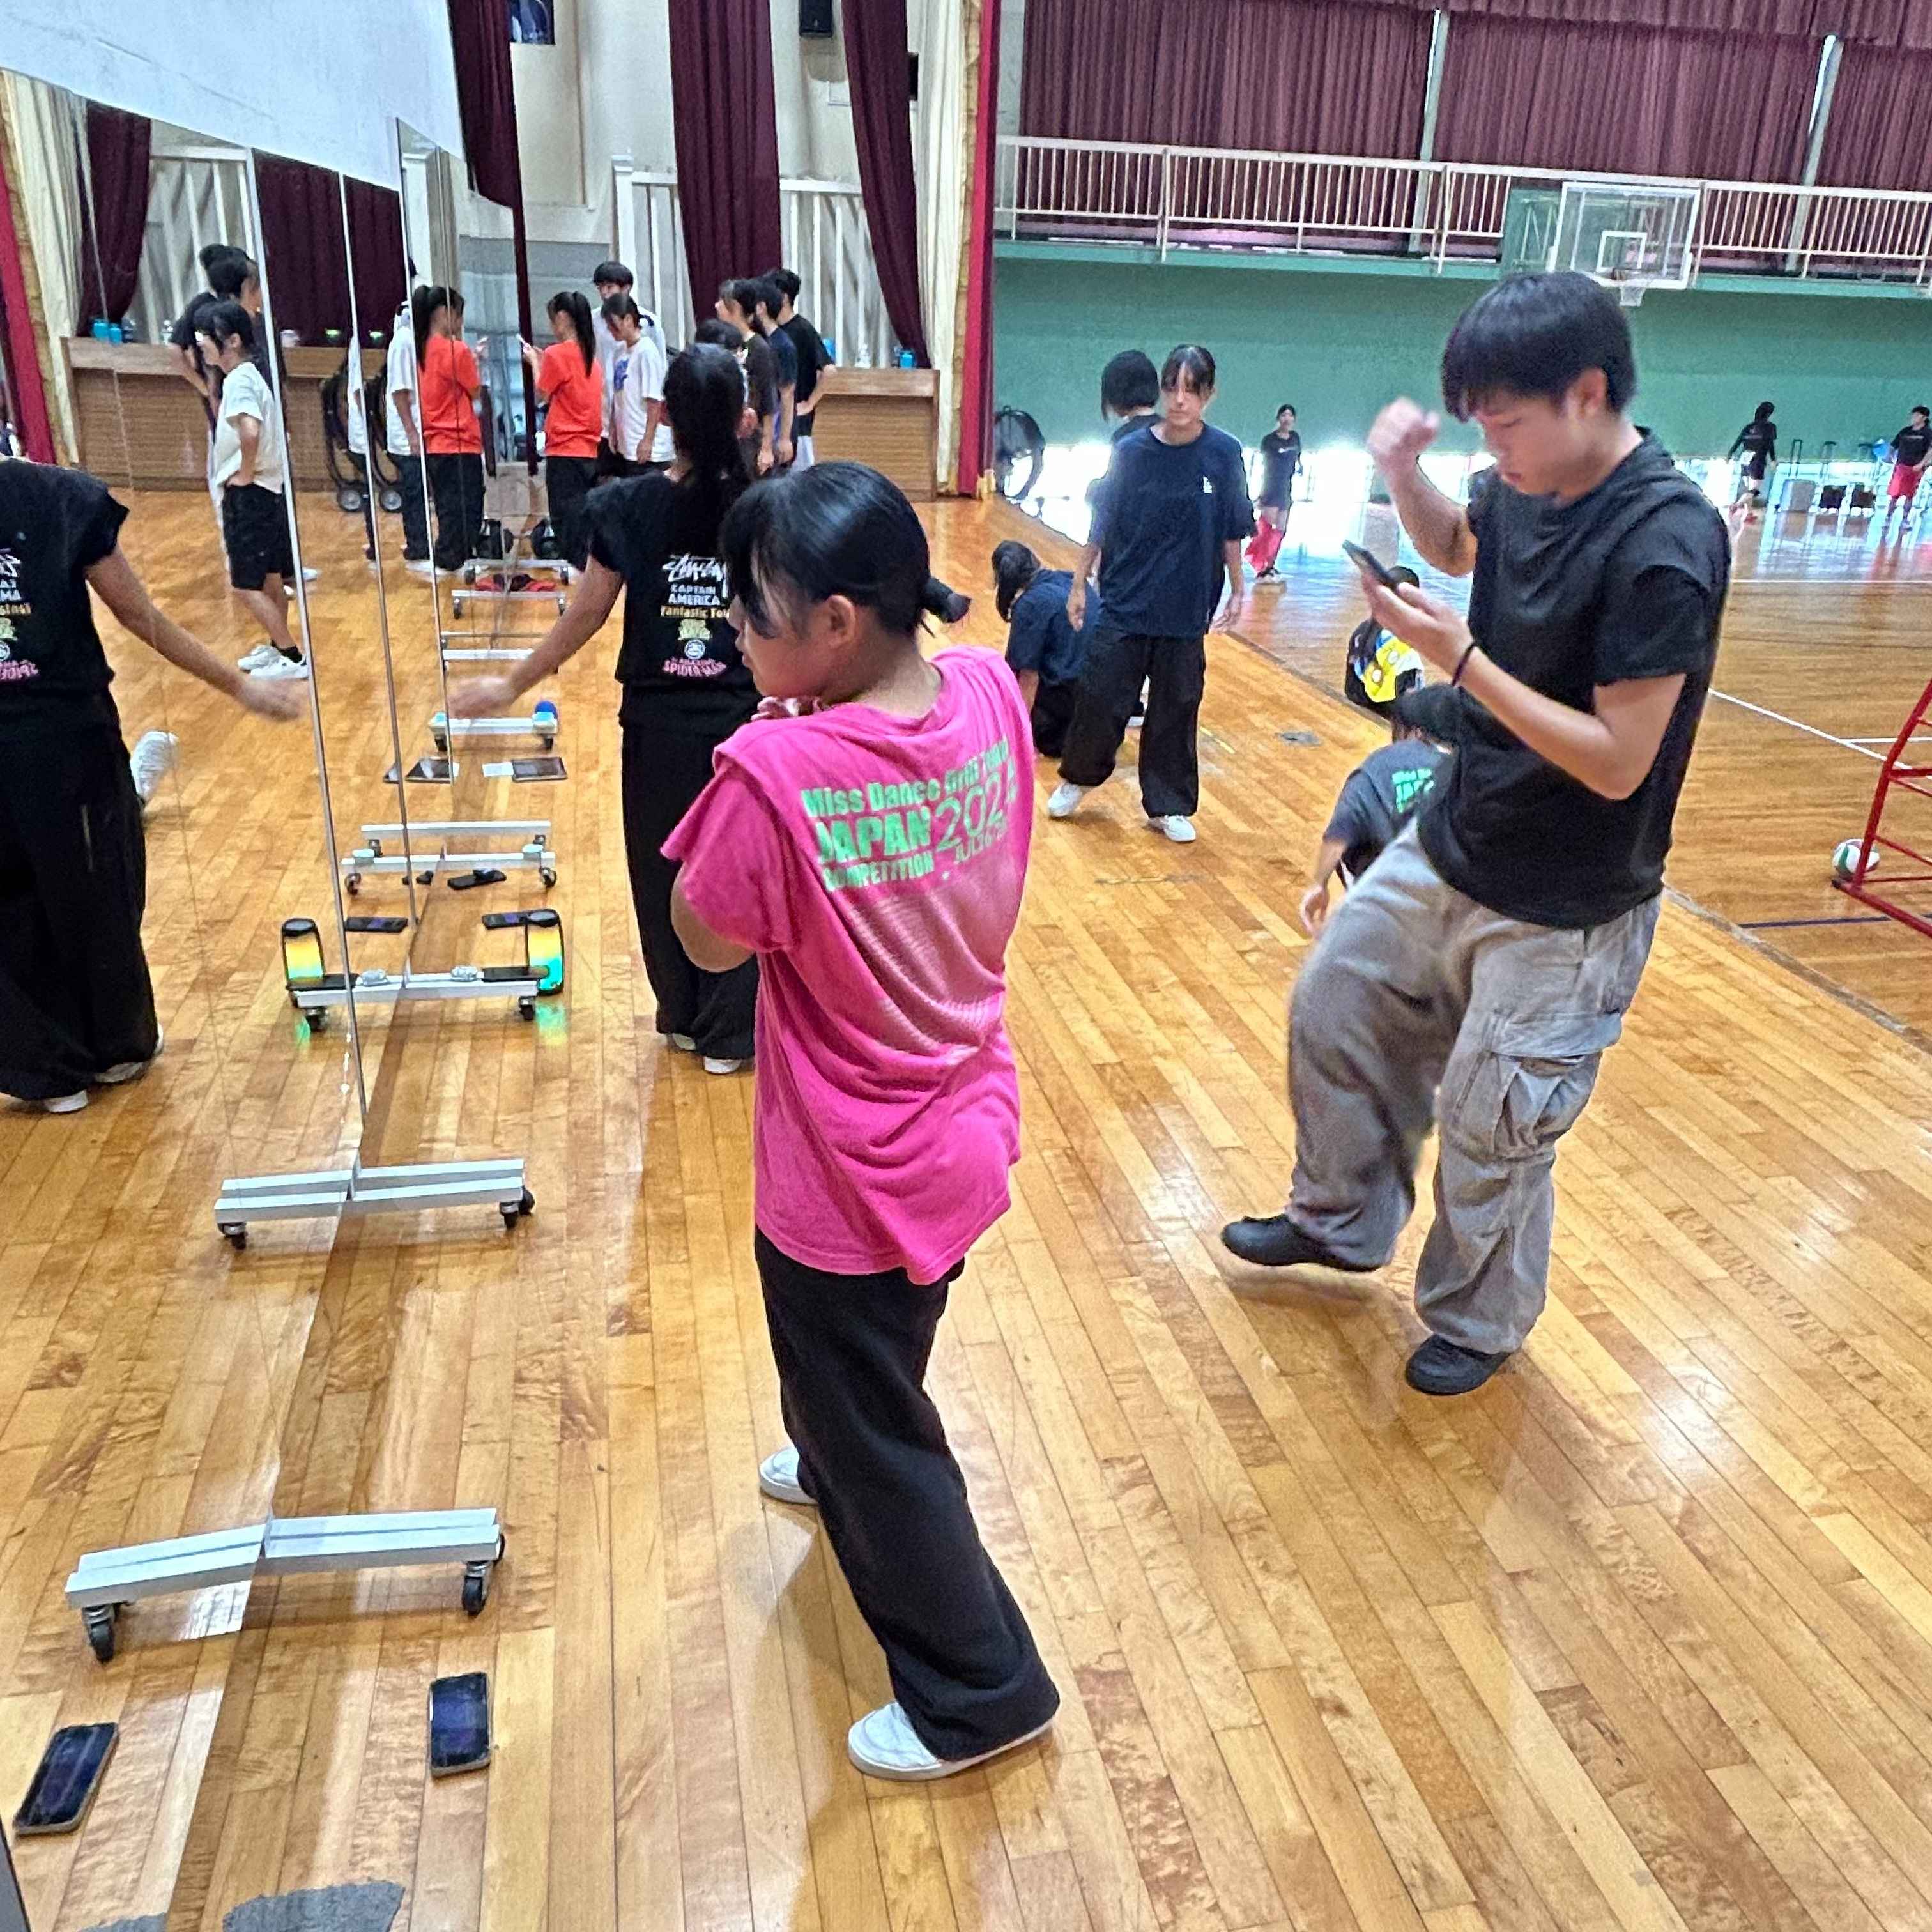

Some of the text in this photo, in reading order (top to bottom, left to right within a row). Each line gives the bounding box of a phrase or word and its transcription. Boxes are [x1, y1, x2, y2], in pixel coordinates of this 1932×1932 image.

[668, 593, 721, 606] AMERICA
[801, 786, 864, 818] Miss
[815, 806, 931, 865] JAPAN
